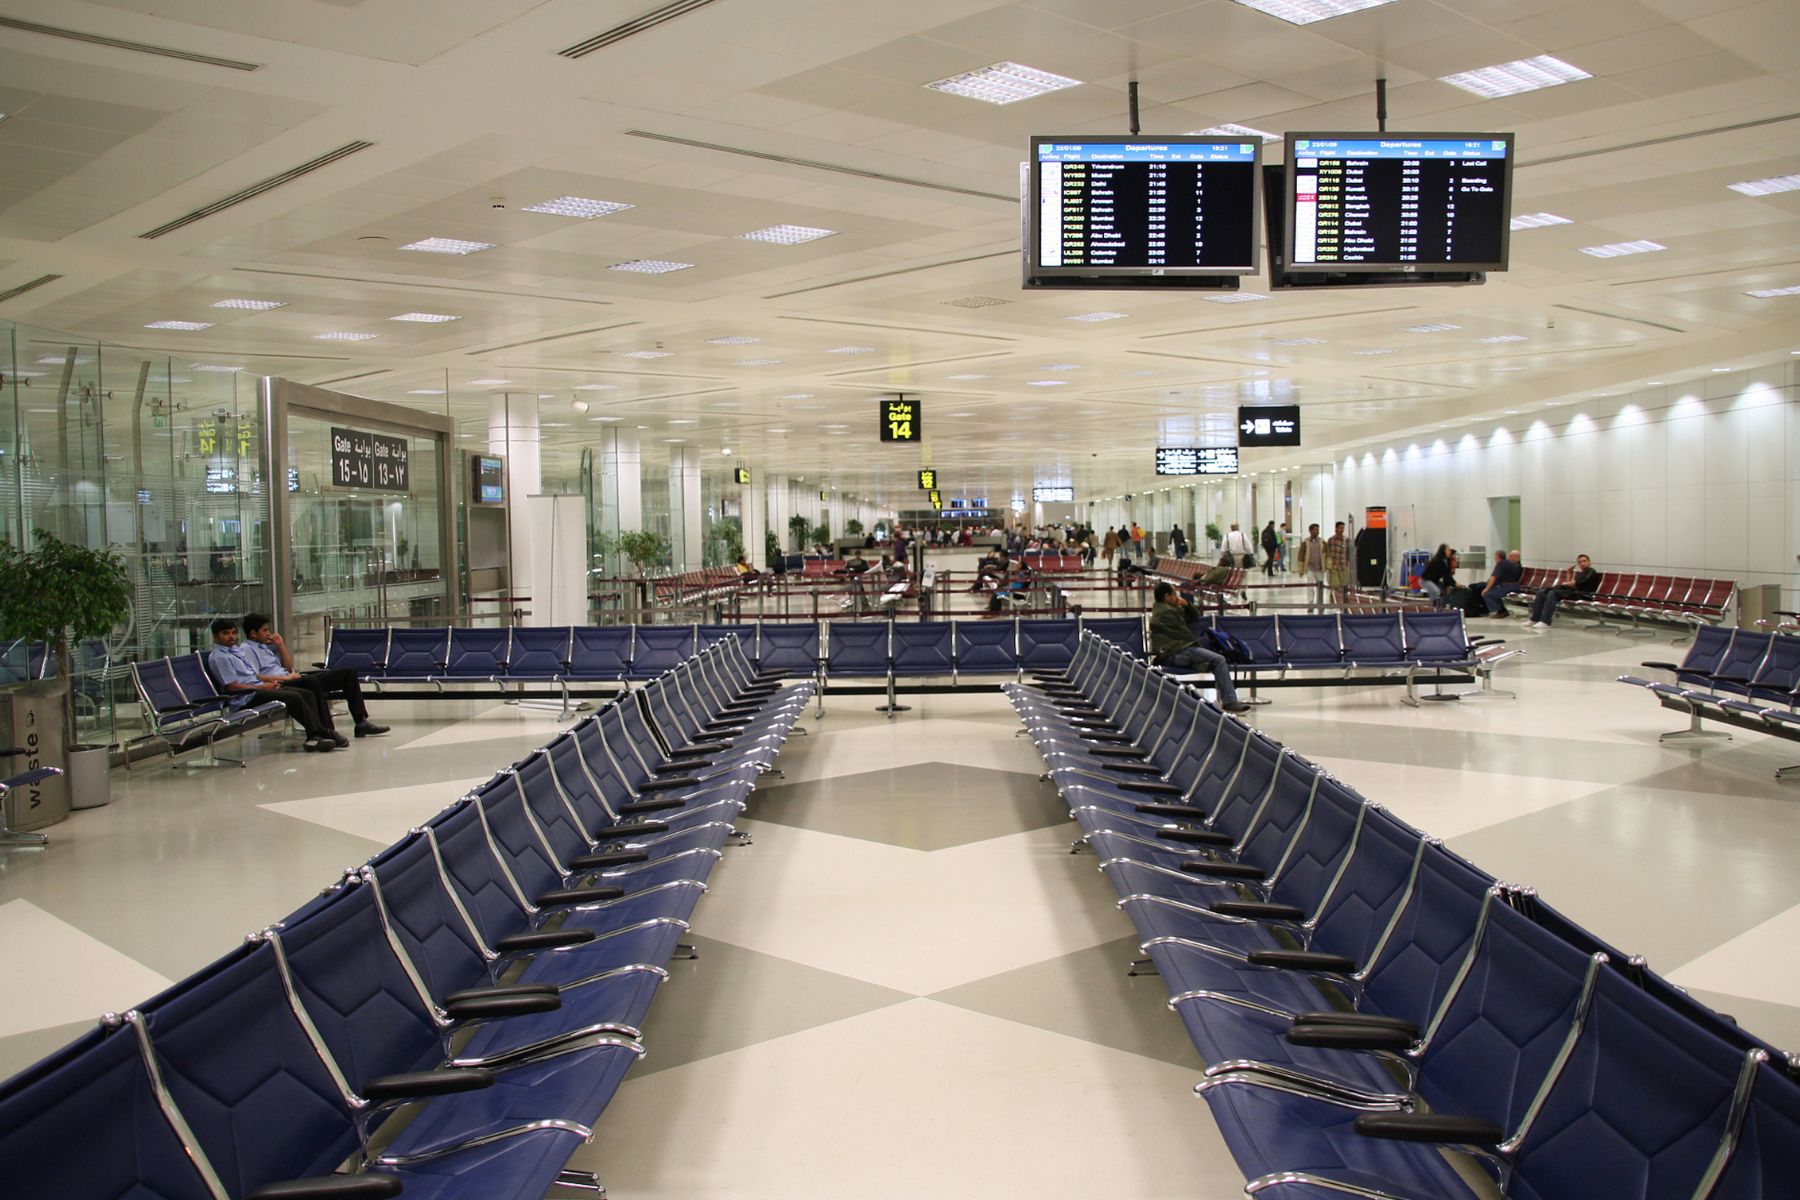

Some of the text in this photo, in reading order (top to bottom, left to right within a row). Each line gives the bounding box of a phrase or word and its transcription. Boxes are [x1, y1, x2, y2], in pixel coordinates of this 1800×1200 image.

[889, 413, 912, 421] Gate
[889, 422, 912, 439] 14
[335, 436, 371, 458] Gate بوابة
[375, 442, 407, 462] Gate بوابة
[922, 480, 933, 488] 12
